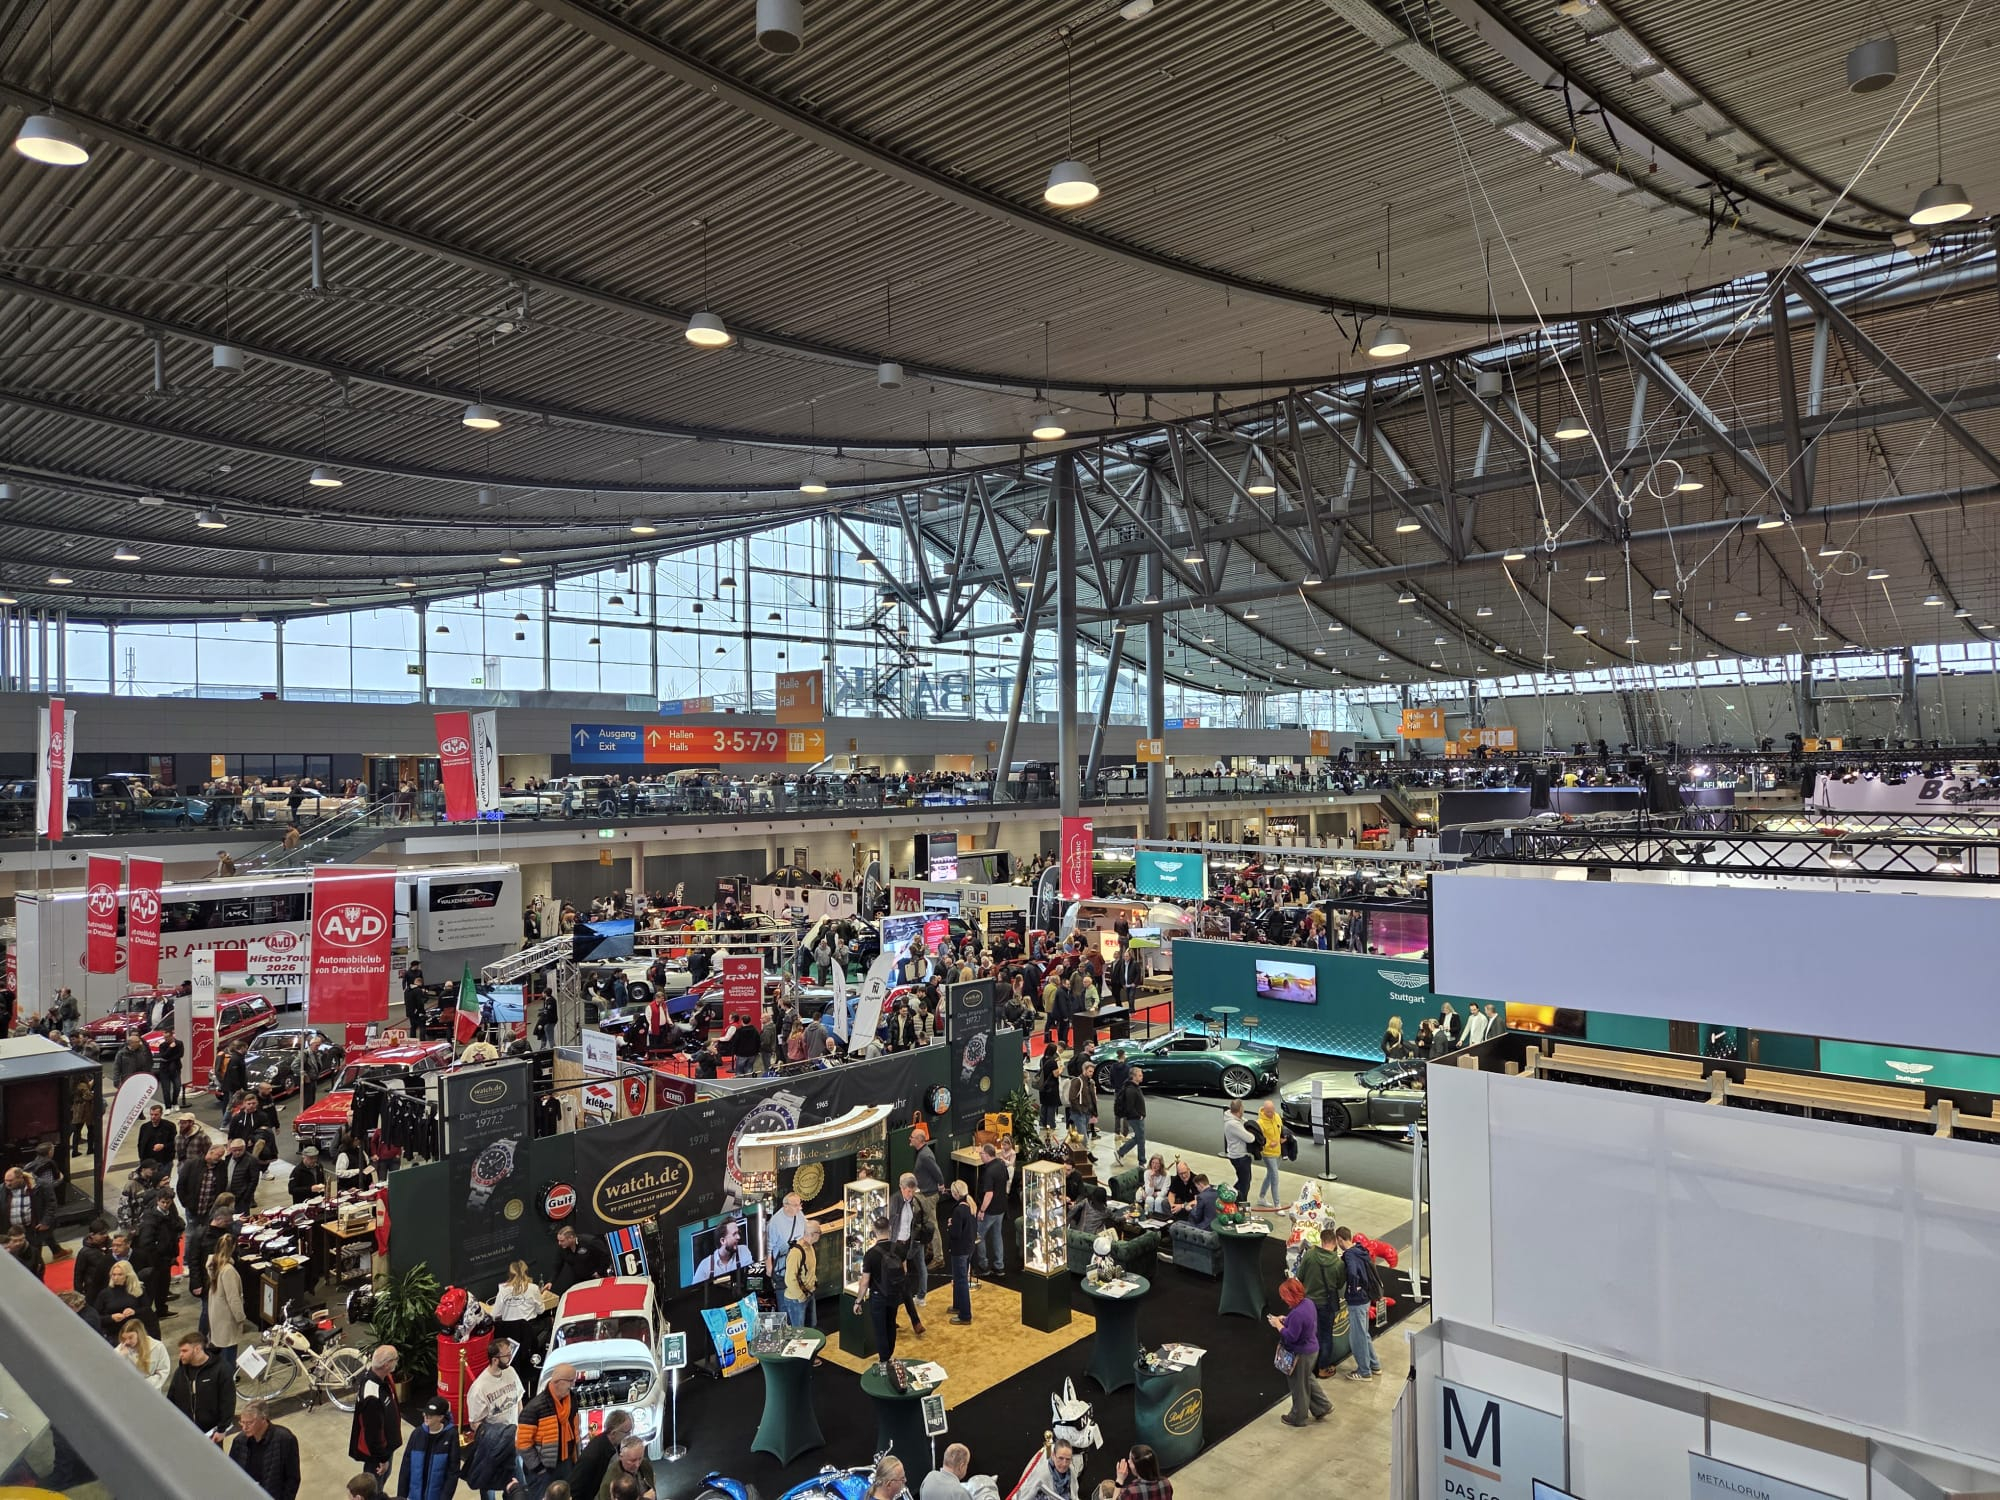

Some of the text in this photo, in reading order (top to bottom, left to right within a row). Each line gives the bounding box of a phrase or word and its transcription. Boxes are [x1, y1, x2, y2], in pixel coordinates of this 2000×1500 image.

[779, 679, 800, 689] Halle
[806, 676, 815, 705] 1
[779, 696, 795, 706] Hall
[1430, 711, 1437, 728] 1
[598, 729, 636, 740] Ausgang
[669, 730, 694, 739] Hallen
[599, 742, 616, 751] Exit
[669, 742, 689, 751] Halls
[131, 900, 158, 920] AvD
[324, 915, 382, 942] AvD
[270, 936, 291, 948] AvD
[319, 955, 382, 964] Automobilclub
[266, 964, 296, 972] 2026
[331, 965, 385, 974] Deutschland
[260, 974, 303, 986] START
[1390, 992, 1425, 1004] Stuttgart
[605, 1166, 680, 1199] watch.de
[549, 1195, 574, 1208] Gulf
[625, 1254, 637, 1276] 6
[727, 1322, 748, 1335] Gulf
[668, 1350, 681, 1361] FIAT
[737, 1347, 747, 1356] 20
[1443, 1386, 1501, 1468] M
[1445, 1480, 1475, 1500] DAS
[1697, 1472, 1770, 1500] METALLORUM
